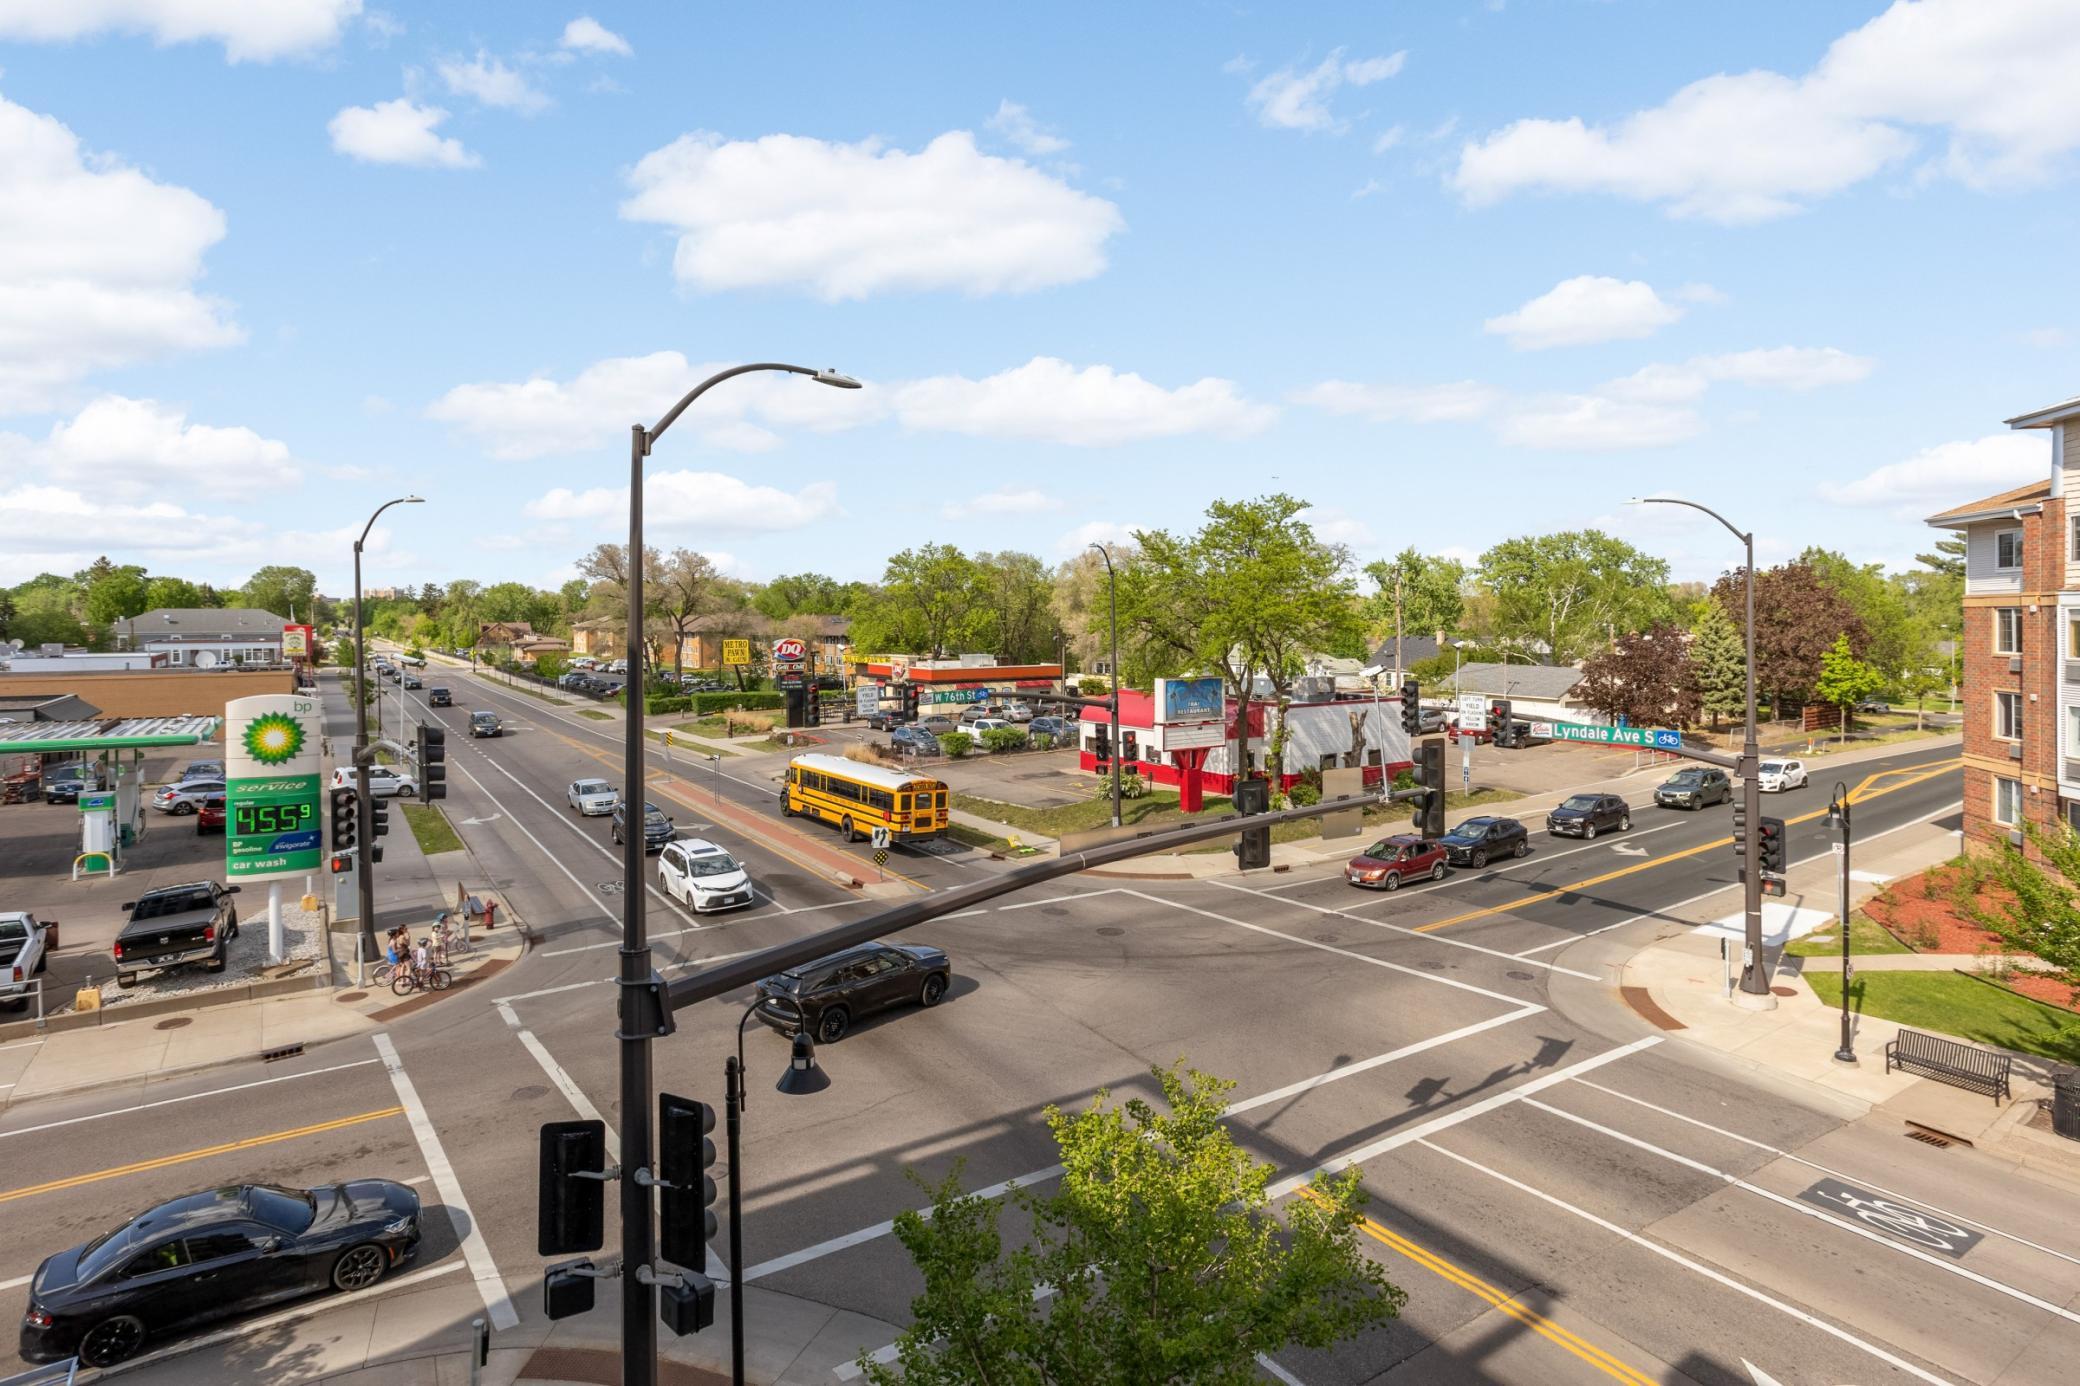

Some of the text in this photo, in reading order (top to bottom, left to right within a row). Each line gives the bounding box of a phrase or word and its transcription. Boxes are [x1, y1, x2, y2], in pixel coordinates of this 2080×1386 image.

[724, 640, 747, 648] METRO
[781, 643, 801, 655] DQ
[935, 693, 942, 702] W
[944, 692, 965, 702] 76th
[967, 691, 976, 700] St
[294, 701, 312, 714] bp
[1554, 724, 1609, 740] Lyndale
[1613, 728, 1641, 743] Ave
[1645, 731, 1655, 744] S
[236, 781, 307, 793] service
[233, 847, 262, 855] gasoline
[233, 858, 287, 870] car wash
